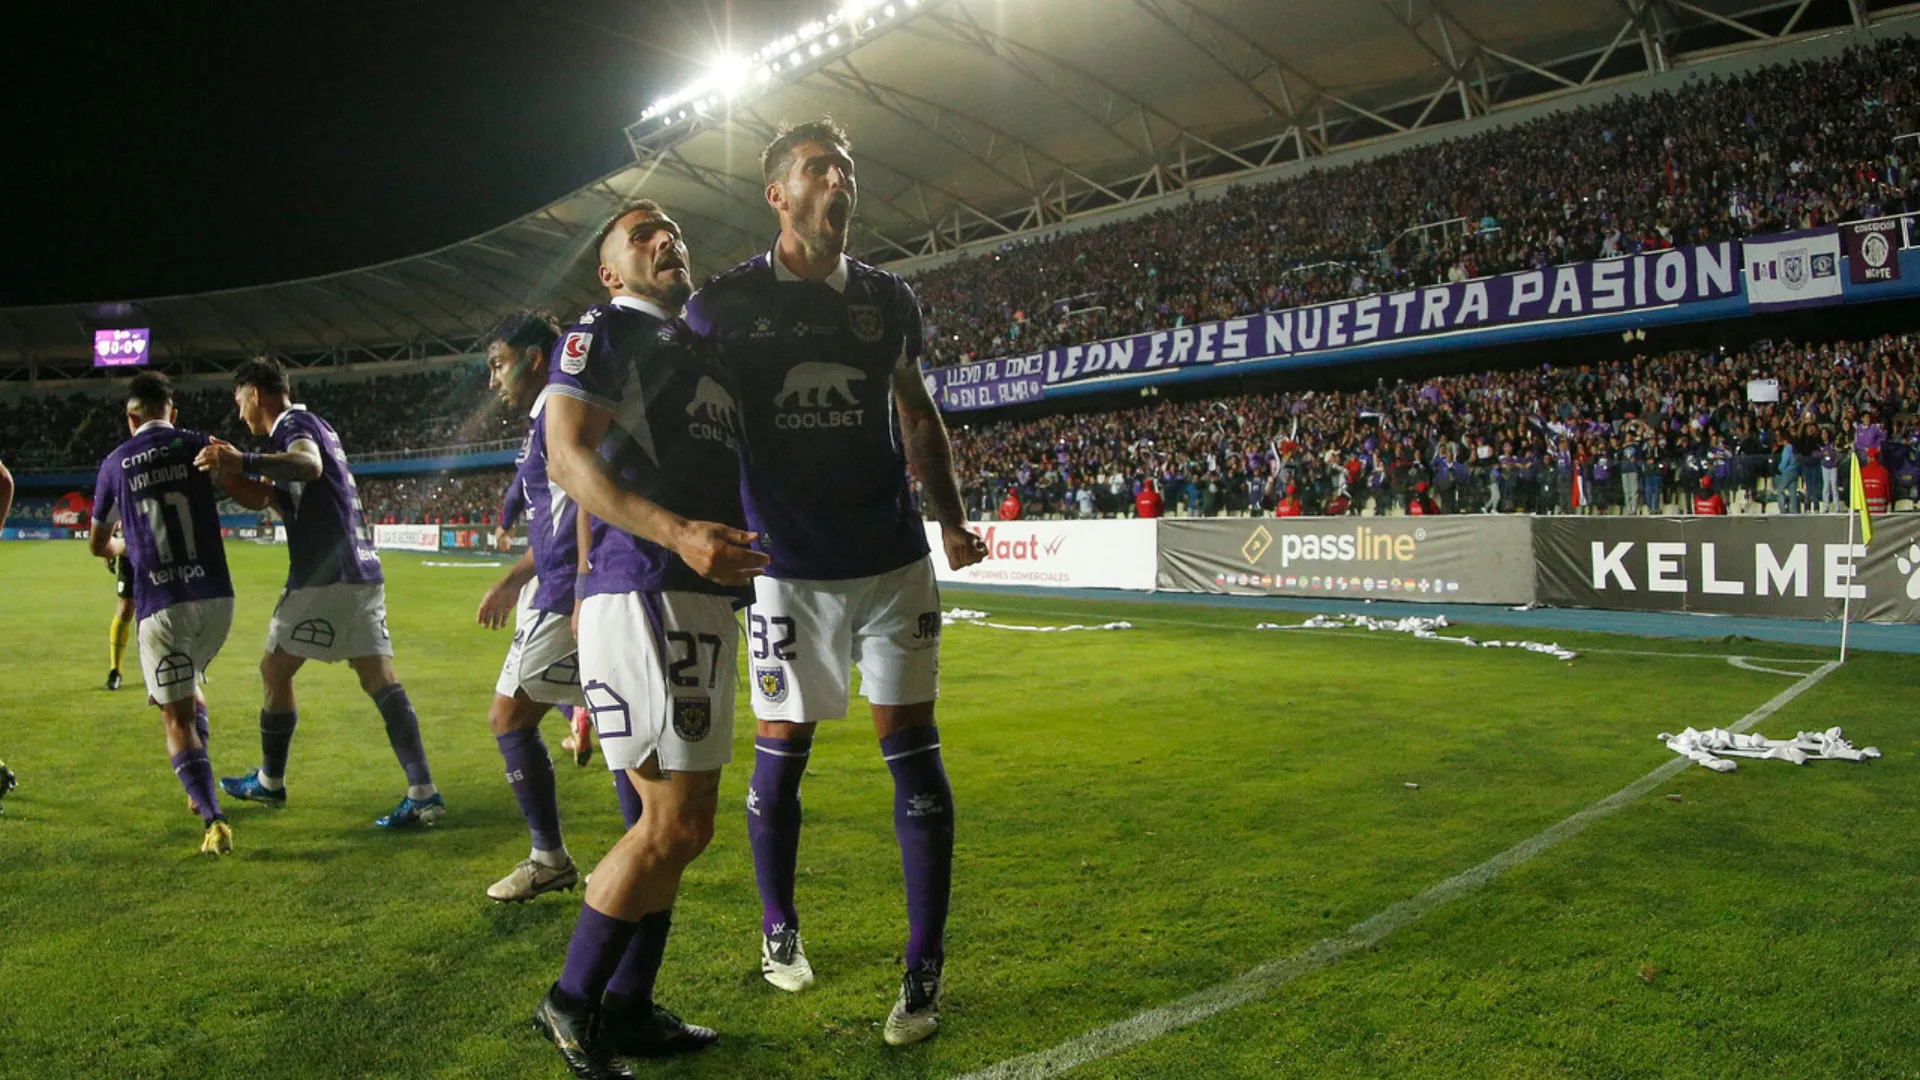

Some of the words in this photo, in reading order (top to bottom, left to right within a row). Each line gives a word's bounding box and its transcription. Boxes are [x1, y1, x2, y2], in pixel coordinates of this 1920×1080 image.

[1046, 339, 1133, 382] LEON
[1146, 319, 1249, 367] ERES
[1265, 281, 1489, 355] NUESTRA
[1508, 242, 1733, 316] PASION
[947, 365, 981, 386] LLEVO
[985, 362, 999, 381] AL
[960, 388, 975, 407] EN
[980, 386, 995, 406] EL
[998, 380, 1029, 402] ALMA
[775, 410, 865, 429] COOLBET
[121, 446, 169, 470] cmpc
[129, 463, 188, 492] VALDIVIA
[136, 491, 198, 564] 11
[969, 570, 1008, 580] INFORMES
[1010, 571, 1071, 582] COMERCIALES
[1591, 541, 1868, 599] KELME
[752, 614, 797, 661] 32
[667, 631, 722, 689] 27
